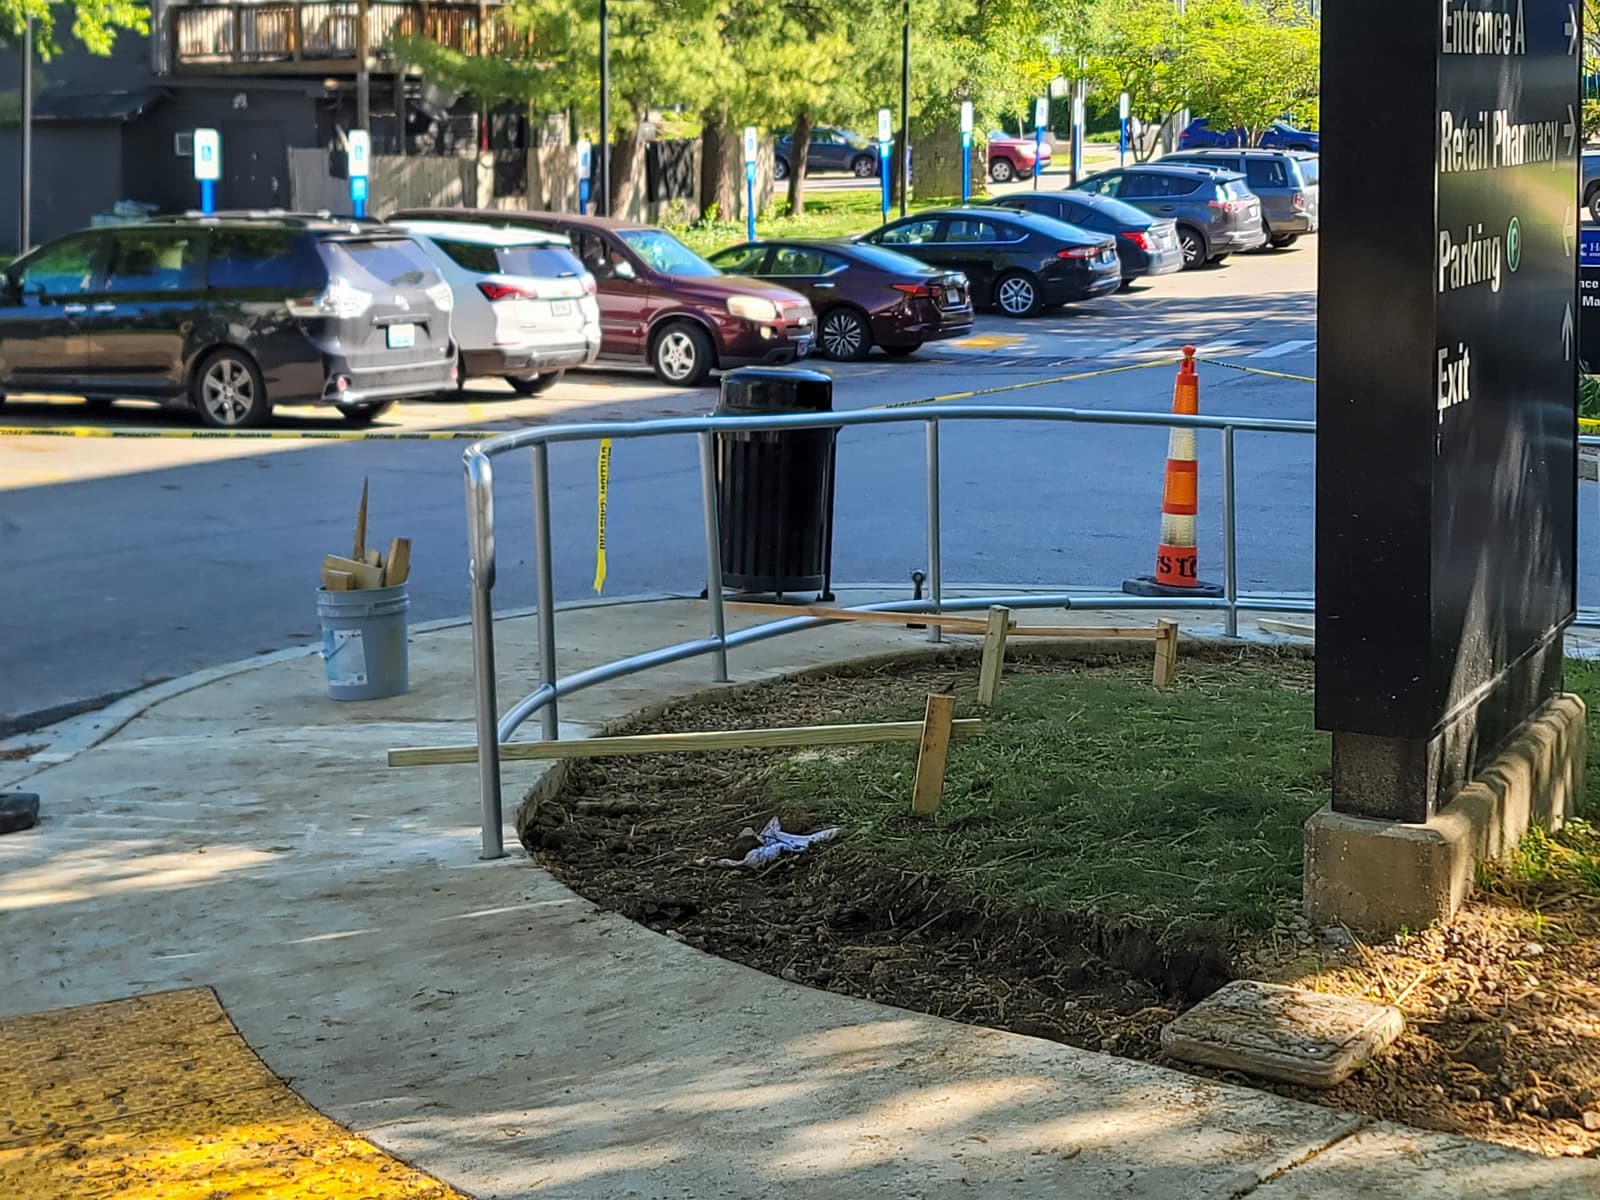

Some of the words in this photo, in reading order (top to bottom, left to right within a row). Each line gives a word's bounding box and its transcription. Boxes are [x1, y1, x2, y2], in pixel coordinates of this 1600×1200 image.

[1442, 0, 1511, 55] Entrance
[1514, 0, 1525, 55] A
[1440, 110, 1488, 172] Retail
[1492, 109, 1558, 172] Pharmacy
[1439, 223, 1500, 292] Parking
[1437, 342, 1470, 411] Exit
